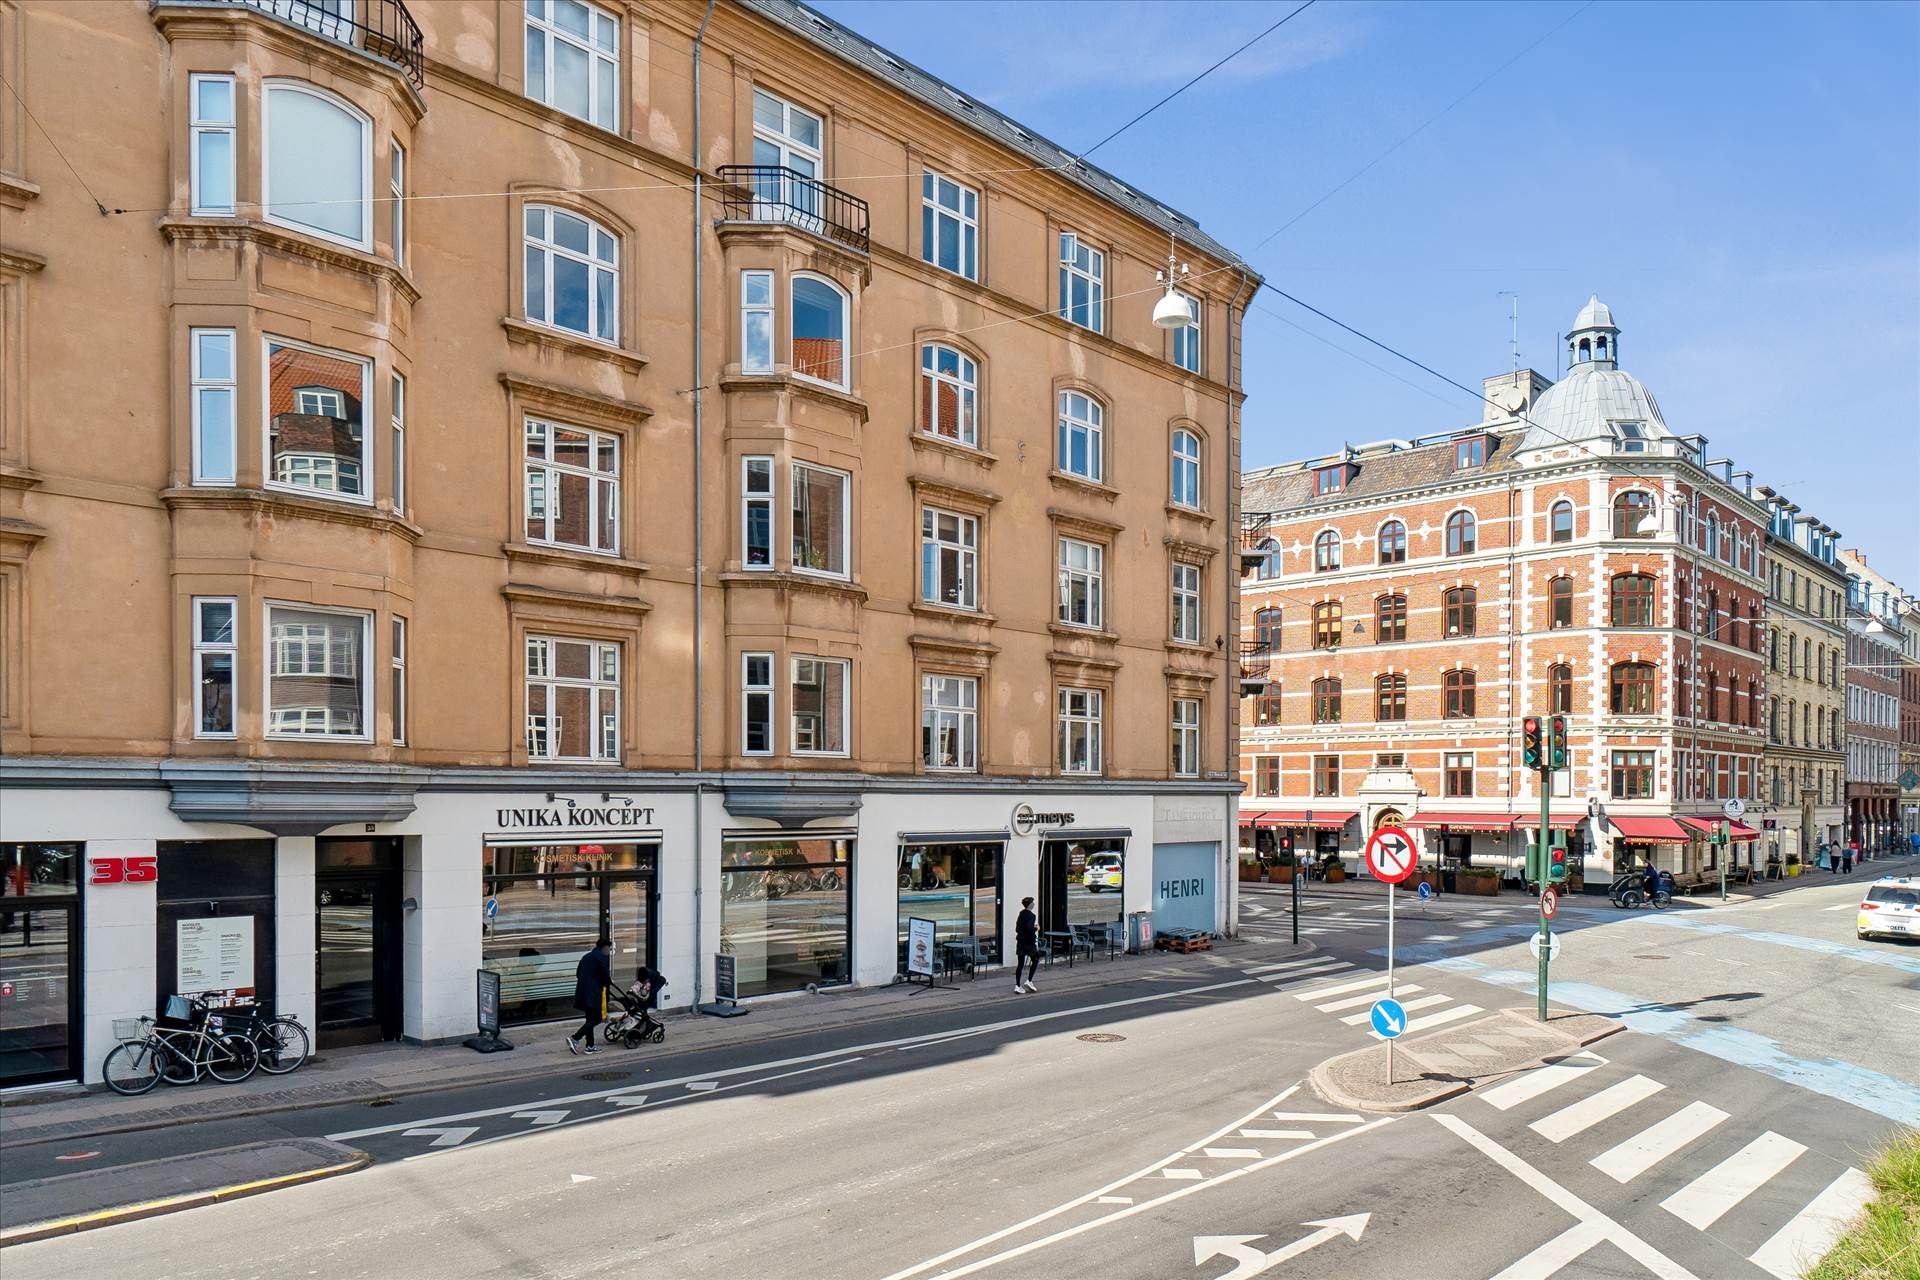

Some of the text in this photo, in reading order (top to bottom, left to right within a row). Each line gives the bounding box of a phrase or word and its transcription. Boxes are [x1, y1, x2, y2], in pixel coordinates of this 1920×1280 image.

[496, 807, 655, 828] UNIKA KONCEPT
[533, 852, 613, 864] KOSMETISK KLINIK
[90, 855, 159, 886] 35
[1160, 878, 1204, 899] HENRI
